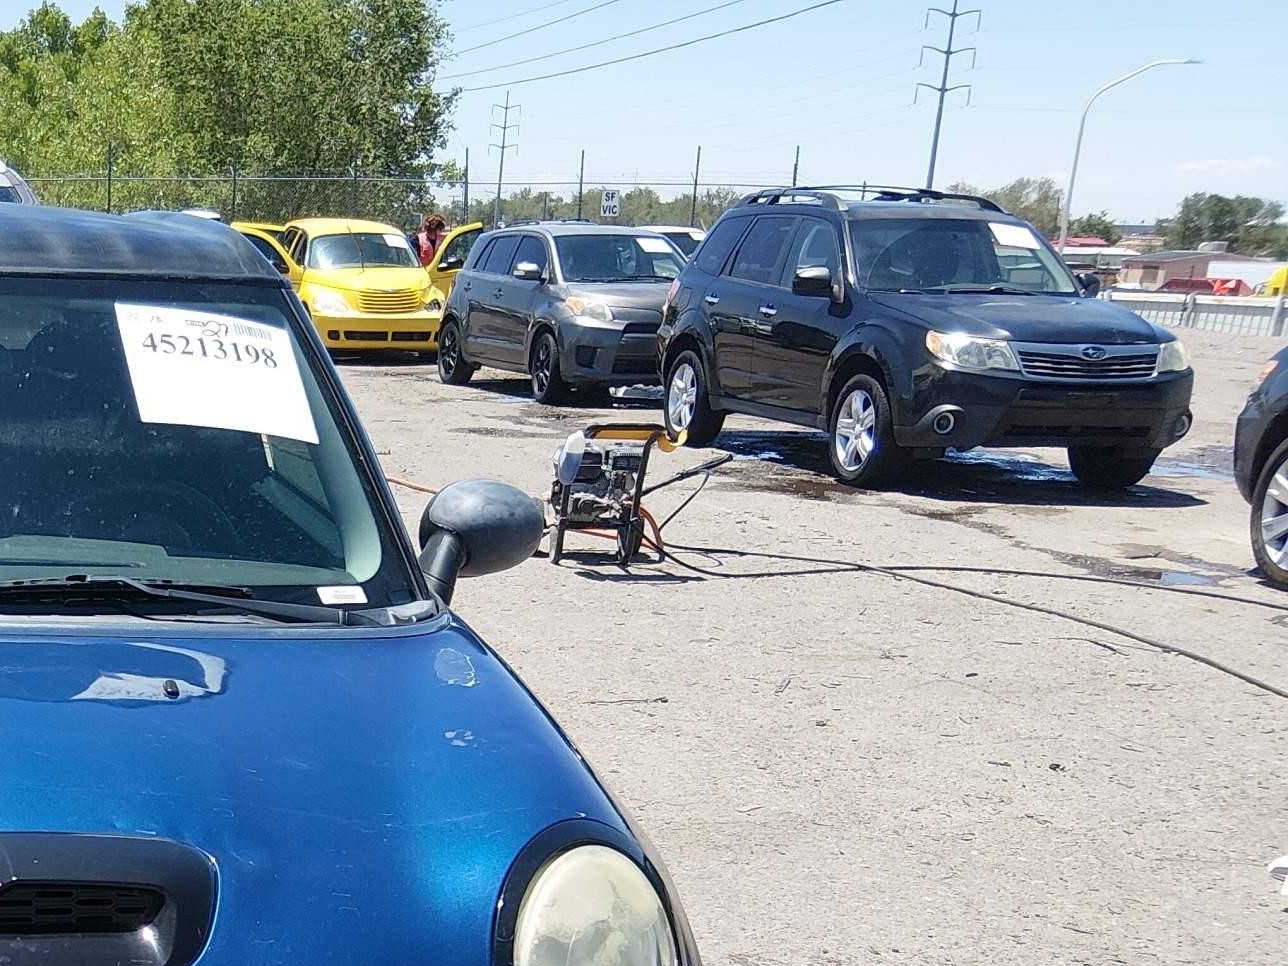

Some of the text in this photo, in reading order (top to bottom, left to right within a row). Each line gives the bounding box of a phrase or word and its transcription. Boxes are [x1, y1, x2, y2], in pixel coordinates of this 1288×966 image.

[605, 192, 616, 202] SF
[602, 204, 617, 215] VIC
[142, 332, 278, 369] 45213198
